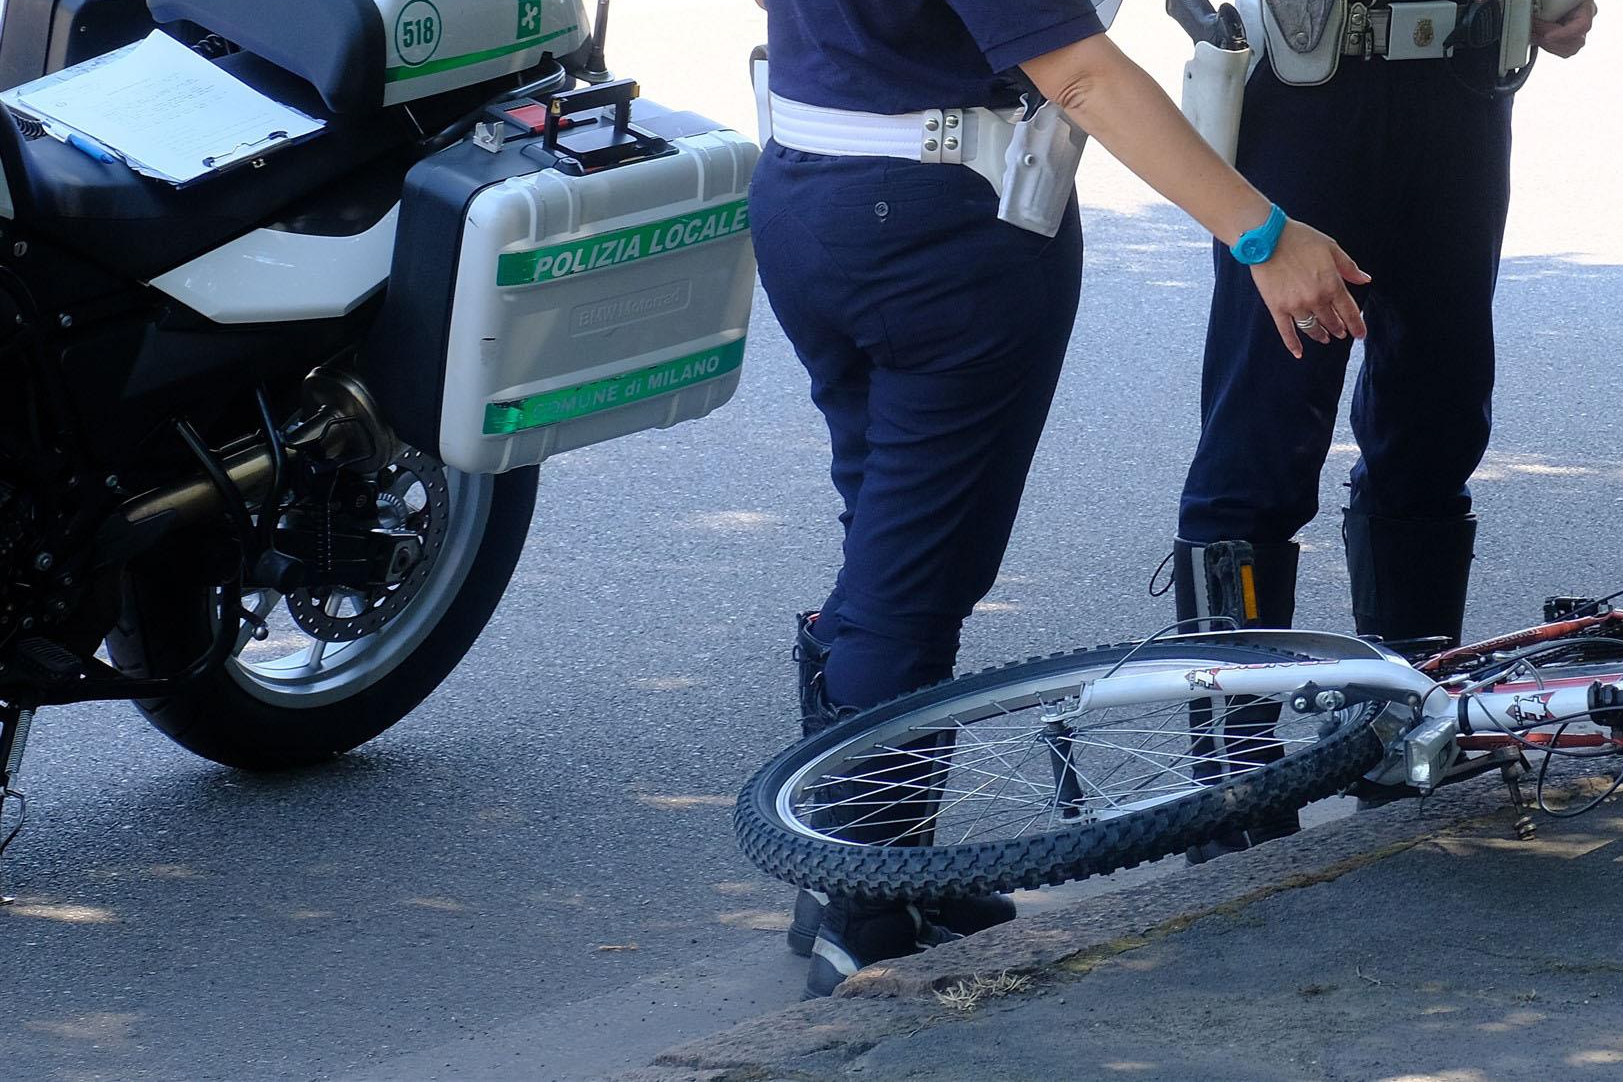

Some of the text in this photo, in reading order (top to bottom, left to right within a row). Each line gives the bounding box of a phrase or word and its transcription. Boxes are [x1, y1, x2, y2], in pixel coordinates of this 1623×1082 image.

[403, 16, 434, 48] 518
[533, 205, 749, 282] POLIZIA LOCALE
[532, 355, 720, 418] COMUNE di MILANO
